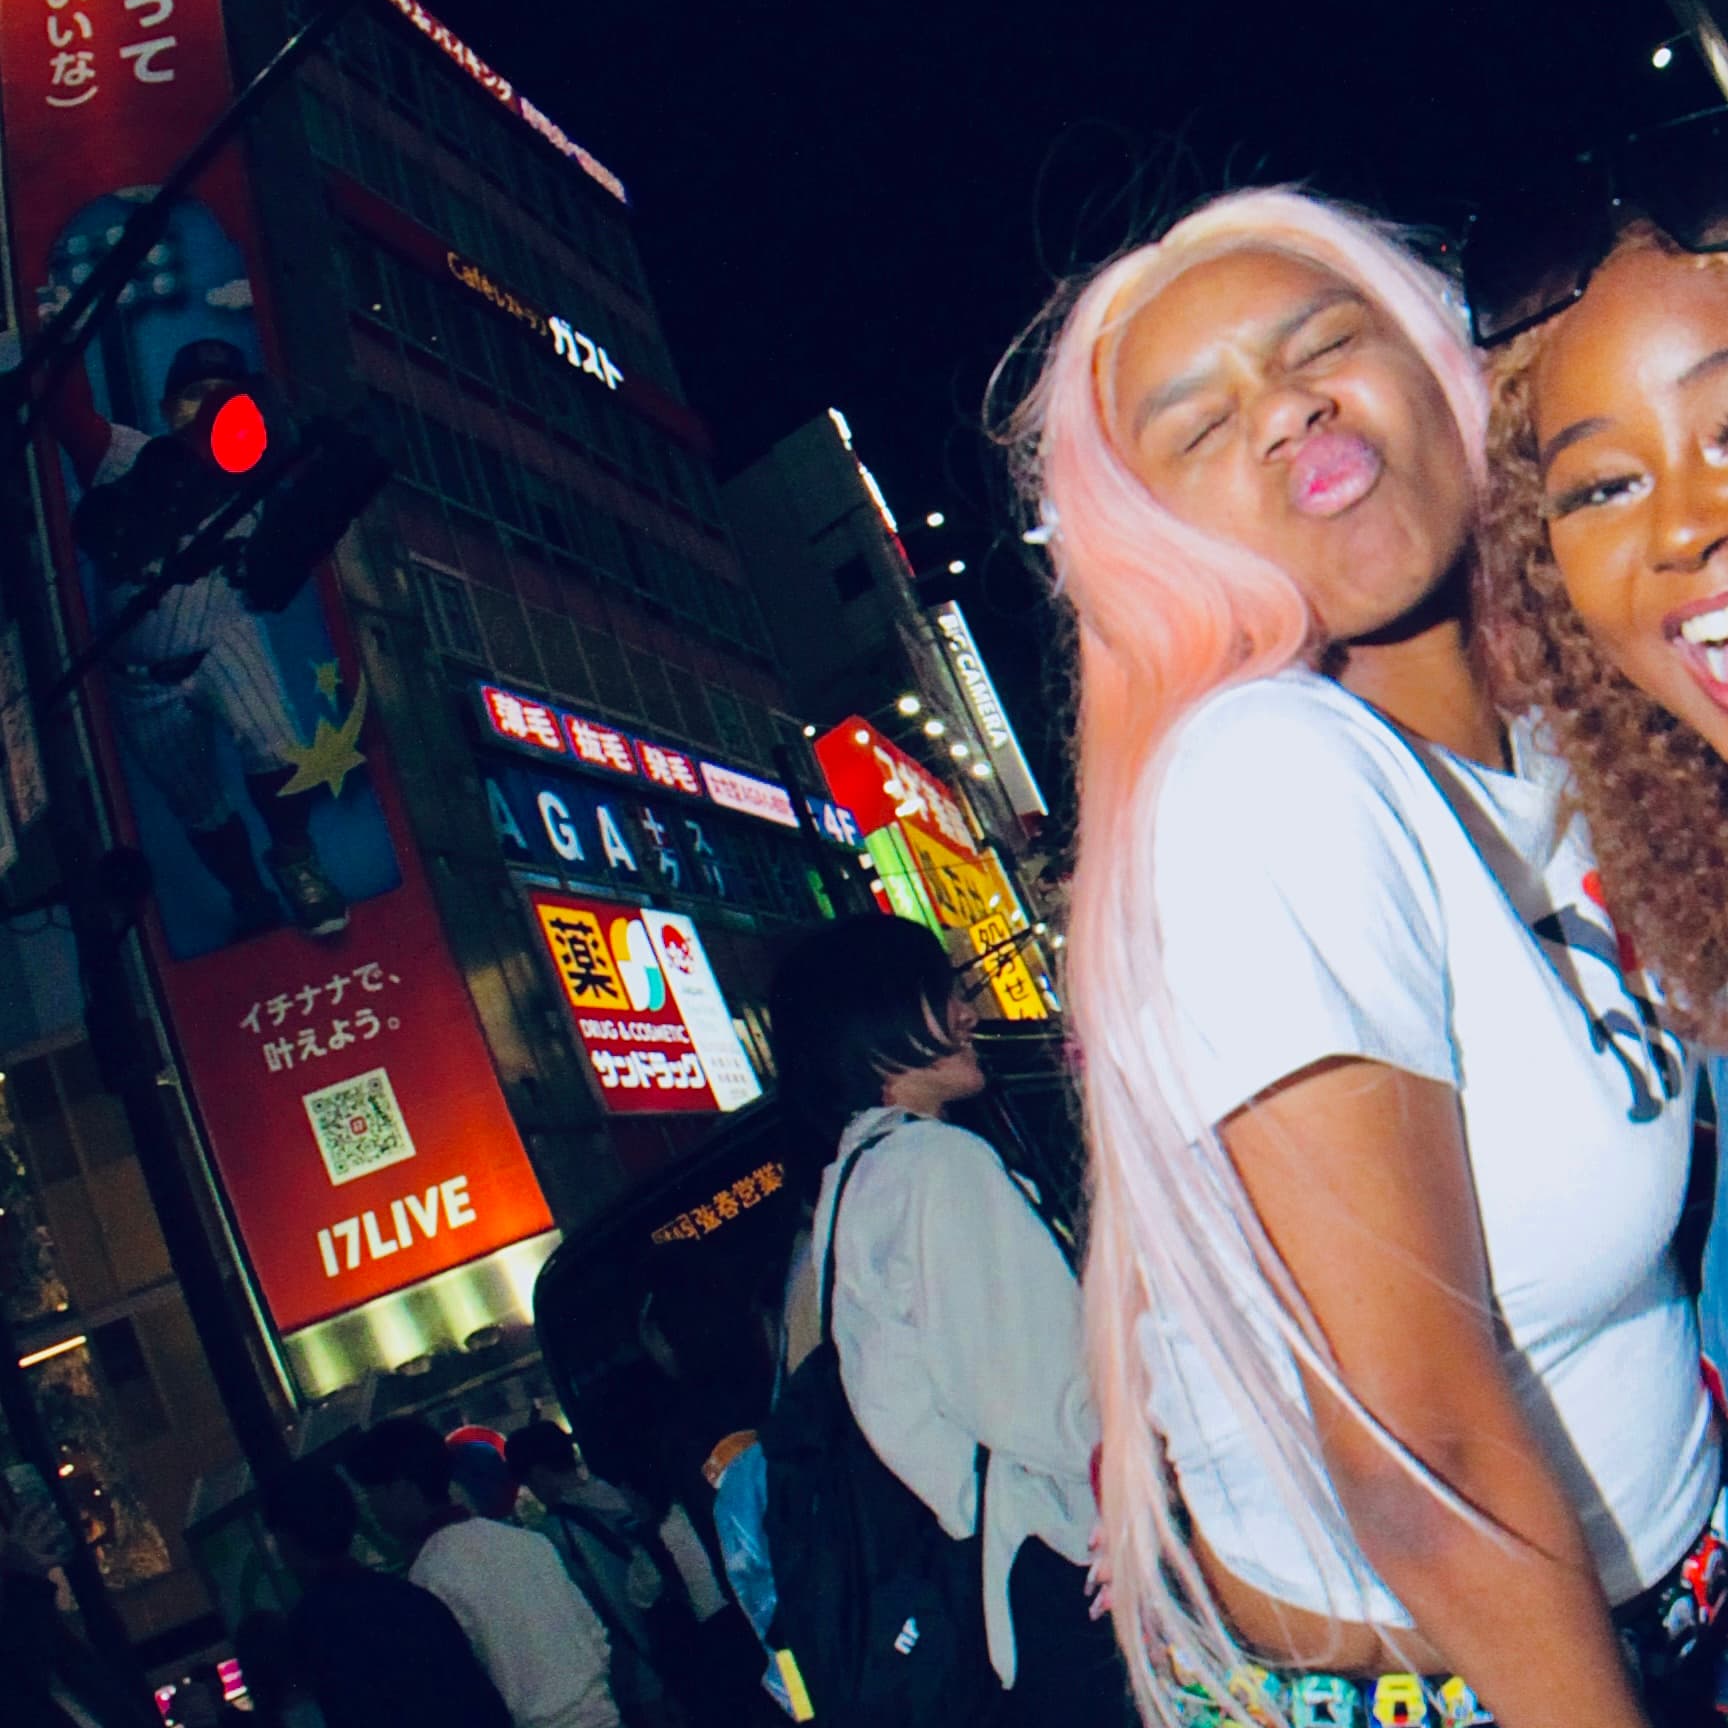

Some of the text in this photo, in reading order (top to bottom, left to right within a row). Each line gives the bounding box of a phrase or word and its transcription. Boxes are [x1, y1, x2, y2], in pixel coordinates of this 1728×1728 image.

[548, 316, 625, 392] ガスト
[956, 650, 1009, 749] CAMERA
[644, 746, 699, 793] 発毛
[549, 918, 618, 998] 薬
[240, 961, 402, 1035] イチナナで、
[580, 1018, 615, 1040] DRUG
[629, 1021, 690, 1045] COSMETIC
[263, 1014, 401, 1072] 叶えよう。
[591, 1049, 706, 1089] サンドラッグ
[316, 1175, 478, 1278] 17LIVE
[689, 1161, 784, 1235] 弦巻営業
